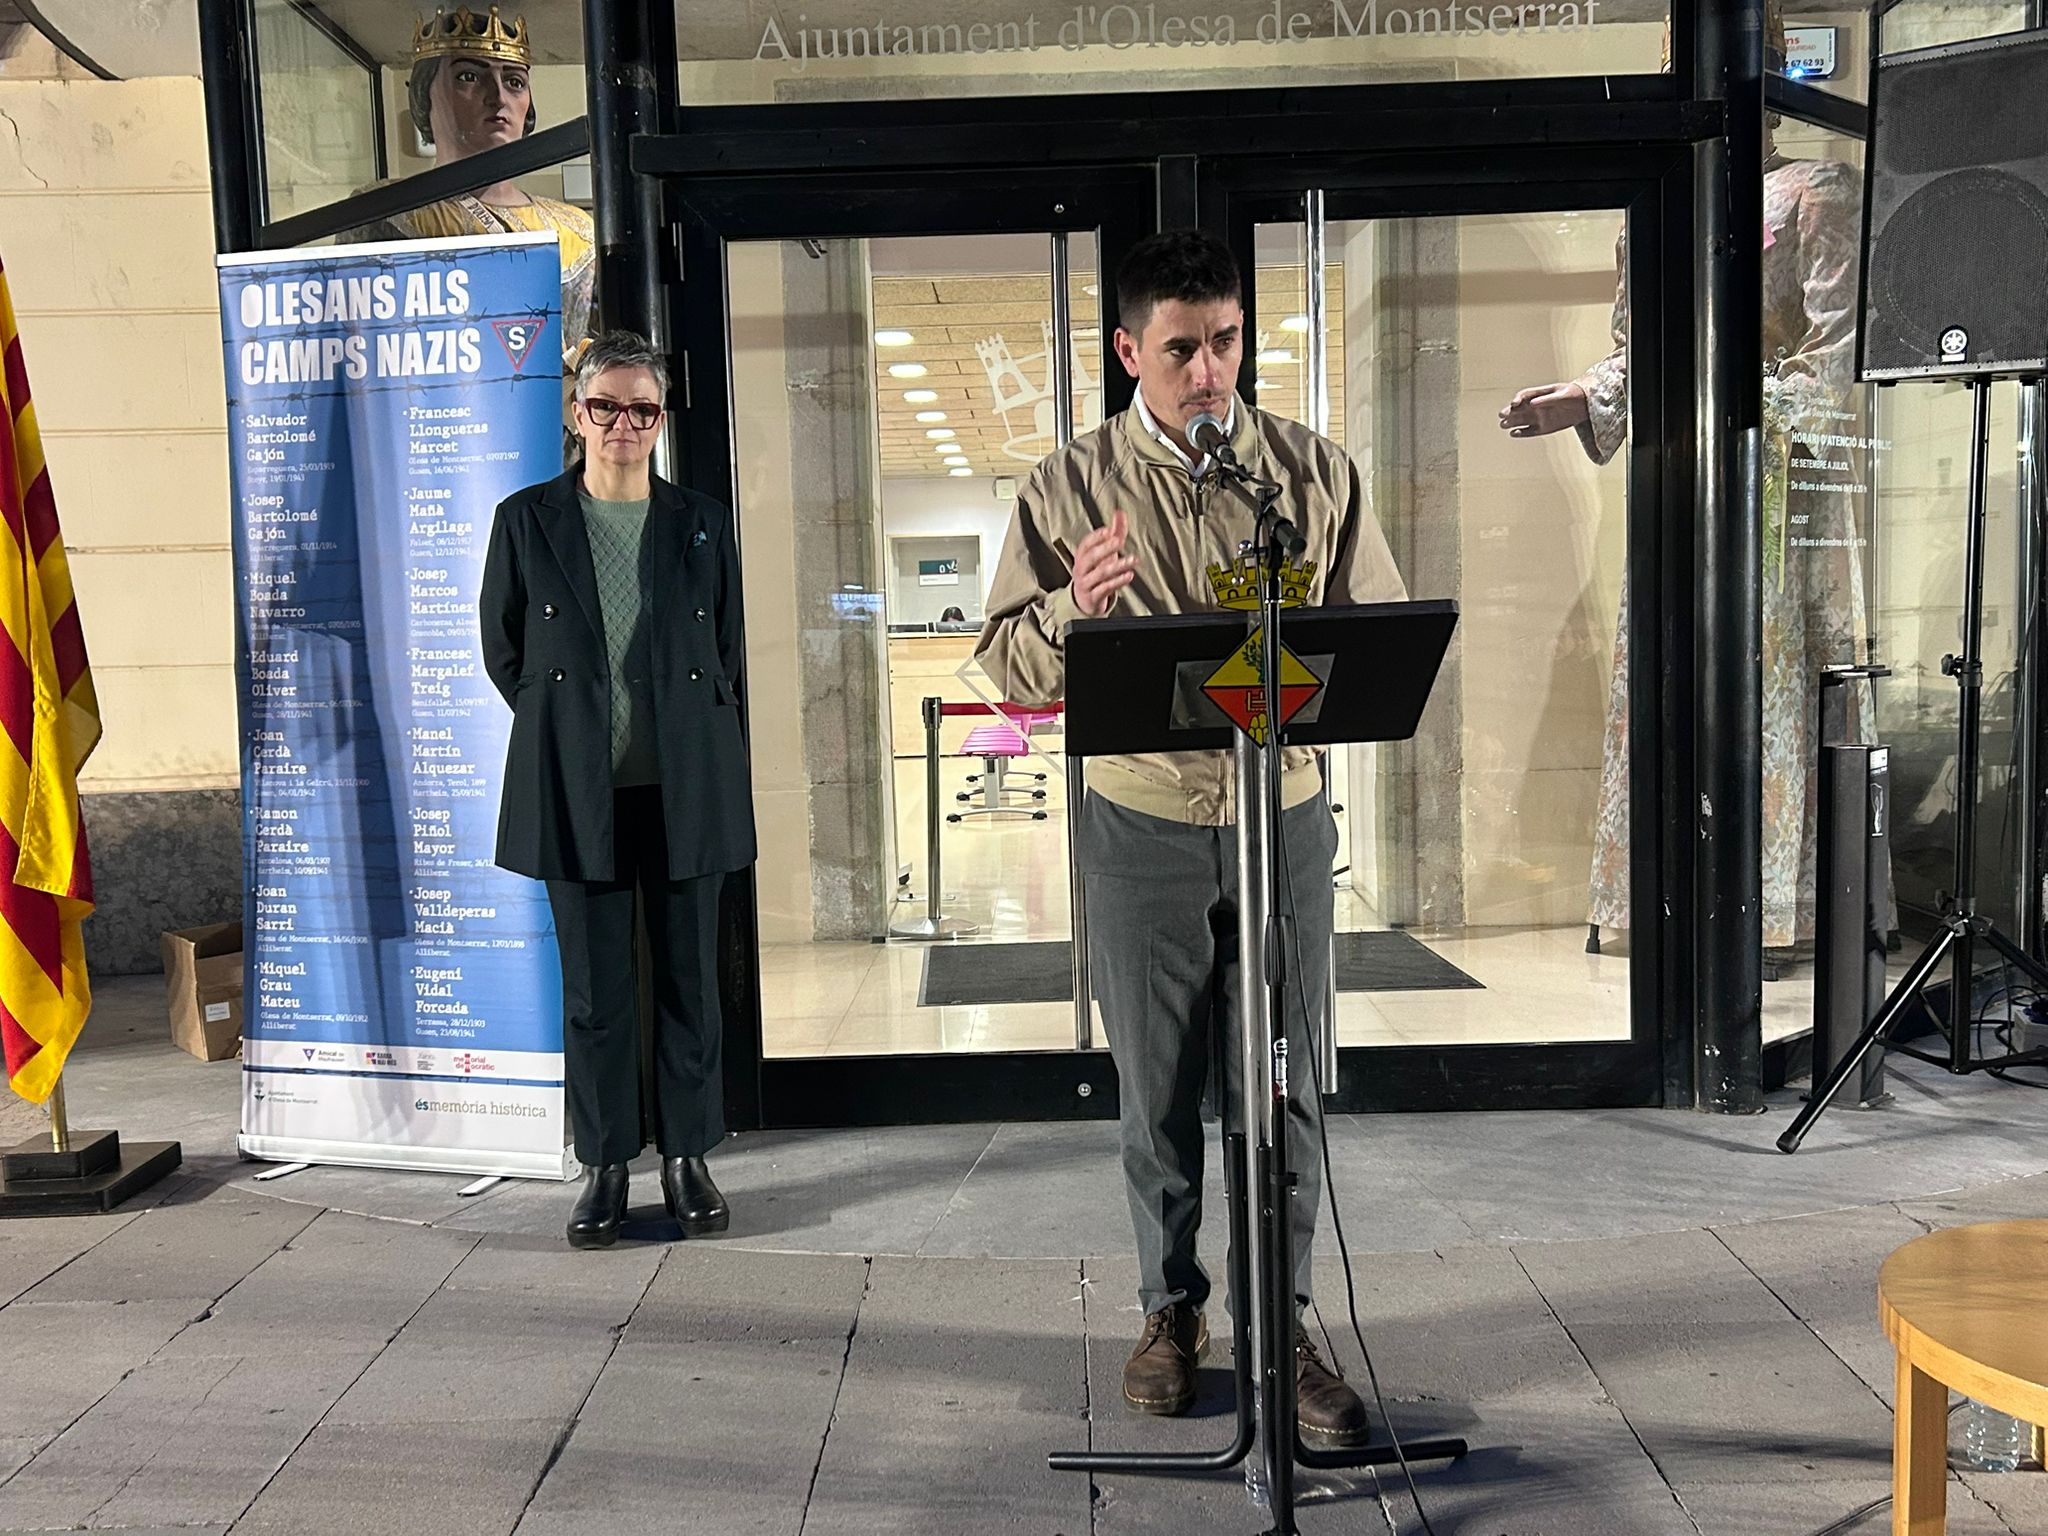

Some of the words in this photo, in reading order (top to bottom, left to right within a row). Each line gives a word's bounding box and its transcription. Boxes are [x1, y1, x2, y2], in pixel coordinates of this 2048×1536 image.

[753, 13, 1040, 73] Ajuntament
[1058, 4, 1236, 51] d'Olesa
[1256, 0, 1312, 45] de
[1334, 0, 1601, 40] Montserrat
[1802, 58, 1813, 67] 62
[1814, 58, 1825, 66] 93
[240, 275, 397, 329] OLESANS
[404, 269, 470, 318] ALS
[507, 326, 527, 351] S
[240, 335, 368, 385] CAMPS
[376, 327, 481, 378] NAZIS
[409, 407, 471, 419] Francesc
[246, 414, 307, 428] Salvador
[247, 430, 316, 444] Bartolomé
[410, 423, 488, 438] Llongueras
[410, 441, 458, 454] Marcet
[1791, 431, 1819, 445] HORARI
[1821, 434, 1857, 449] D'ATENCIÓ
[1858, 438, 1867, 449] AL
[1868, 439, 1892, 451] PBLIC
[247, 448, 285, 463] Gajón
[409, 487, 452, 500] Jaume
[248, 494, 283, 508] Josep
[248, 510, 317, 523] Bartolomé
[409, 504, 444, 516] Mañà
[1790, 514, 1809, 525] AGOST
[249, 527, 285, 541] Gajón
[410, 521, 472, 536] Argilaga
[250, 572, 296, 587] Miquel
[410, 568, 447, 582] Josep
[250, 589, 288, 601] Boada
[410, 584, 458, 597] Marcos
[250, 606, 305, 617] Navarro
[410, 601, 474, 614] Martínez
[251, 651, 298, 663] Eduard
[410, 647, 472, 660] Francesc
[252, 668, 289, 679] Boada
[411, 664, 474, 680] Margalef
[252, 684, 296, 696] Oliver
[412, 682, 451, 697] Treig
[253, 729, 284, 741] Joan
[412, 727, 453, 740] Manel
[254, 745, 291, 758] Cerdà
[412, 744, 461, 757] Martín
[254, 762, 307, 774] Paraire
[413, 762, 475, 777] Alquezar
[255, 807, 298, 819] Ramon
[413, 807, 450, 822] Josep
[256, 824, 293, 836] Cerdà
[413, 824, 452, 837] Piñol
[257, 841, 309, 852] Paraire
[414, 841, 455, 856] Mayor
[257, 885, 287, 897] Joan
[415, 887, 451, 902] Josep
[257, 902, 297, 914] Duran
[415, 904, 496, 920] Valldeperas
[414, 921, 454, 933] Macià
[259, 962, 306, 977] Miquel
[415, 966, 463, 982] Eugeni
[260, 979, 291, 991] Grau
[415, 983, 453, 996] Vidal
[261, 995, 300, 1008] Mateu
[415, 1000, 468, 1014] Forcada
[490, 1101, 547, 1118] històrica
